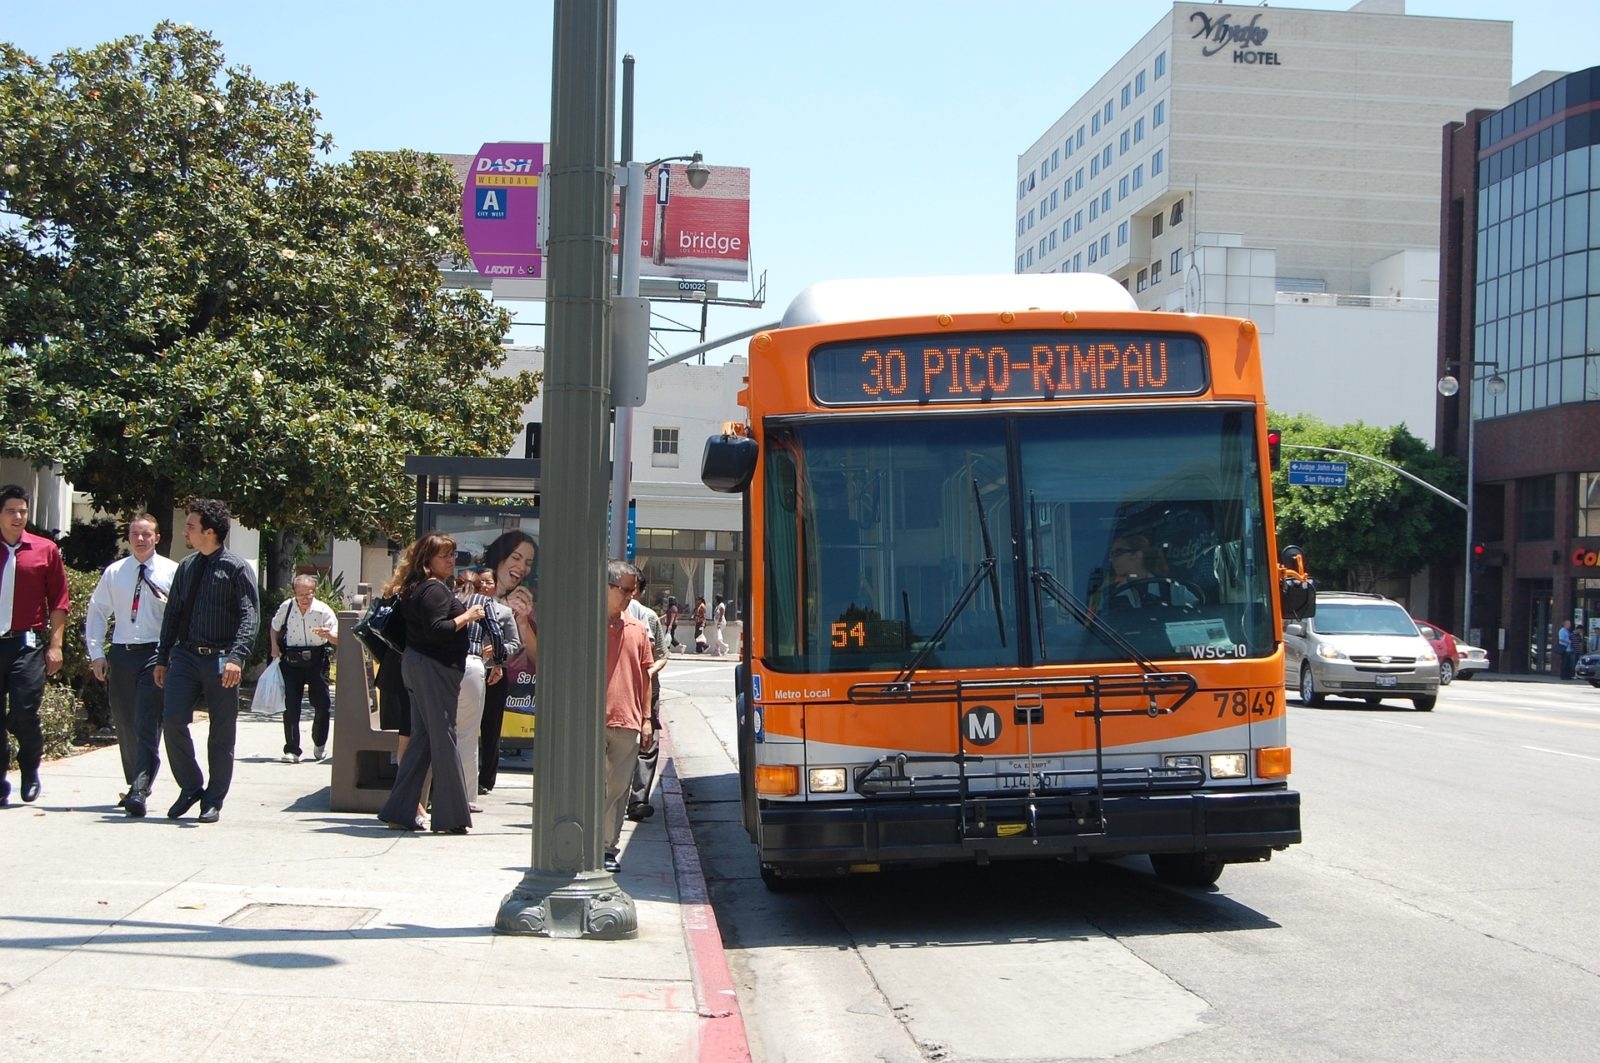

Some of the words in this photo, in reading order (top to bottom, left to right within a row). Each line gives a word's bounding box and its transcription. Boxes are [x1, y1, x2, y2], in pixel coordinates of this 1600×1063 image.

[1233, 50, 1281, 65] HOTEL
[476, 157, 533, 173] DASH
[478, 176, 529, 185] WEEKDAY
[482, 190, 500, 211] A
[680, 230, 741, 254] bridge
[484, 265, 515, 275] LADOT
[679, 282, 706, 290] 001022
[861, 348, 908, 396] 30
[922, 342, 1169, 394] PICO-RIMPAU
[1304, 474, 1316, 483] San
[1317, 475, 1335, 484] Pedro
[831, 621, 866, 648] 54
[1190, 643, 1247, 659] WSC-10
[517, 672, 531, 684] Se
[774, 689, 801, 700] Metro
[803, 687, 831, 699] Local
[506, 695, 531, 708] tomó
[1213, 690, 1275, 718] 7849
[968, 712, 996, 740] M
